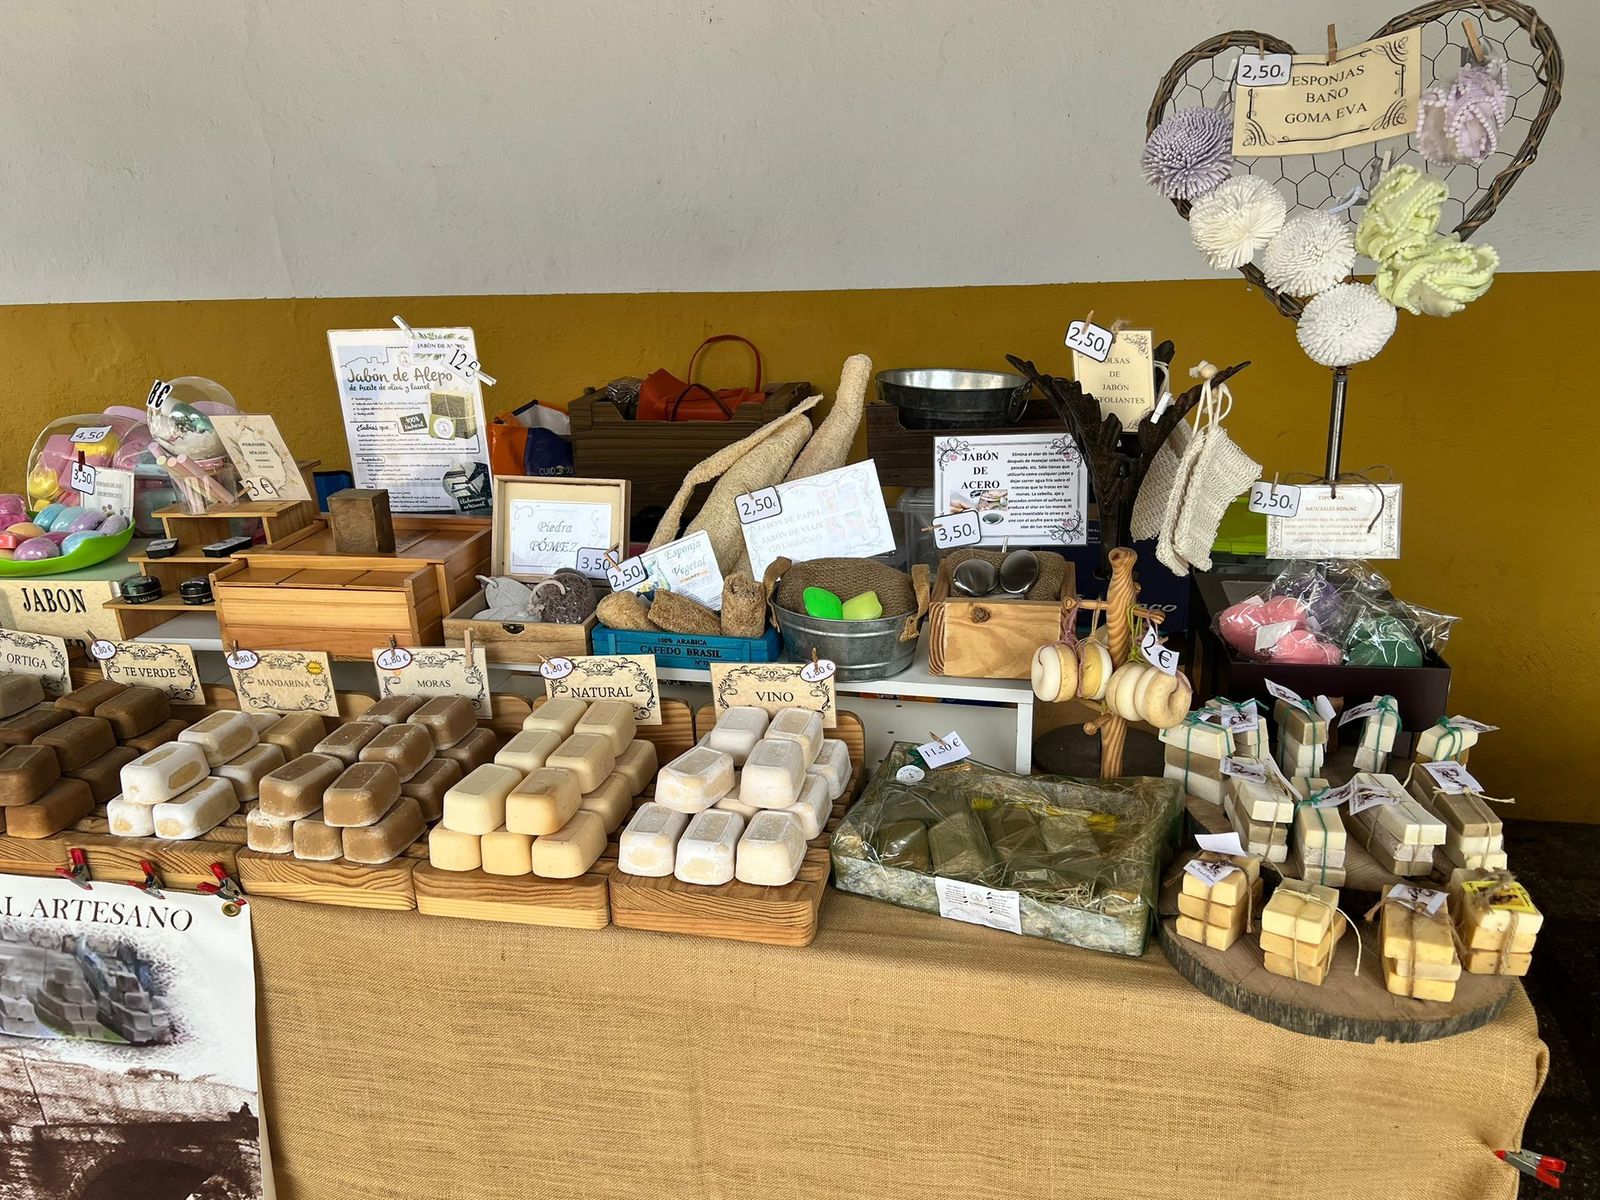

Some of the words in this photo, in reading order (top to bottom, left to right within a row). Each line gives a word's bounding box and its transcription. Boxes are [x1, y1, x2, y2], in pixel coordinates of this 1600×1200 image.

[1291, 64, 1366, 87] ESPONJAS
[1305, 87, 1349, 103] BAÑO
[1284, 111, 1331, 124] GOMA
[1336, 102, 1368, 119] EVA
[1101, 357, 1131, 365] OLSAS
[347, 366, 390, 383] Jabón
[392, 366, 409, 382] de
[414, 366, 453, 387] Alepo
[75, 431, 105, 441] 4,50
[961, 450, 999, 461] JABÓN
[973, 467, 988, 475] DE
[960, 480, 1000, 490] ACERO
[537, 520, 573, 533] Piedra
[21, 587, 87, 613] JABON
[686, 647, 722, 658] BRASIL
[6, 652, 47, 669] ORTIGA
[122, 666, 137, 677] TE
[139, 667, 177, 678] VERDE
[257, 678, 311, 689] MANDARINA
[417, 679, 451, 688] MORAS
[571, 686, 633, 698] NATURAL
[755, 691, 794, 703] VINO
[0, 896, 22, 917] L
[29, 898, 193, 932] ARTESANO
